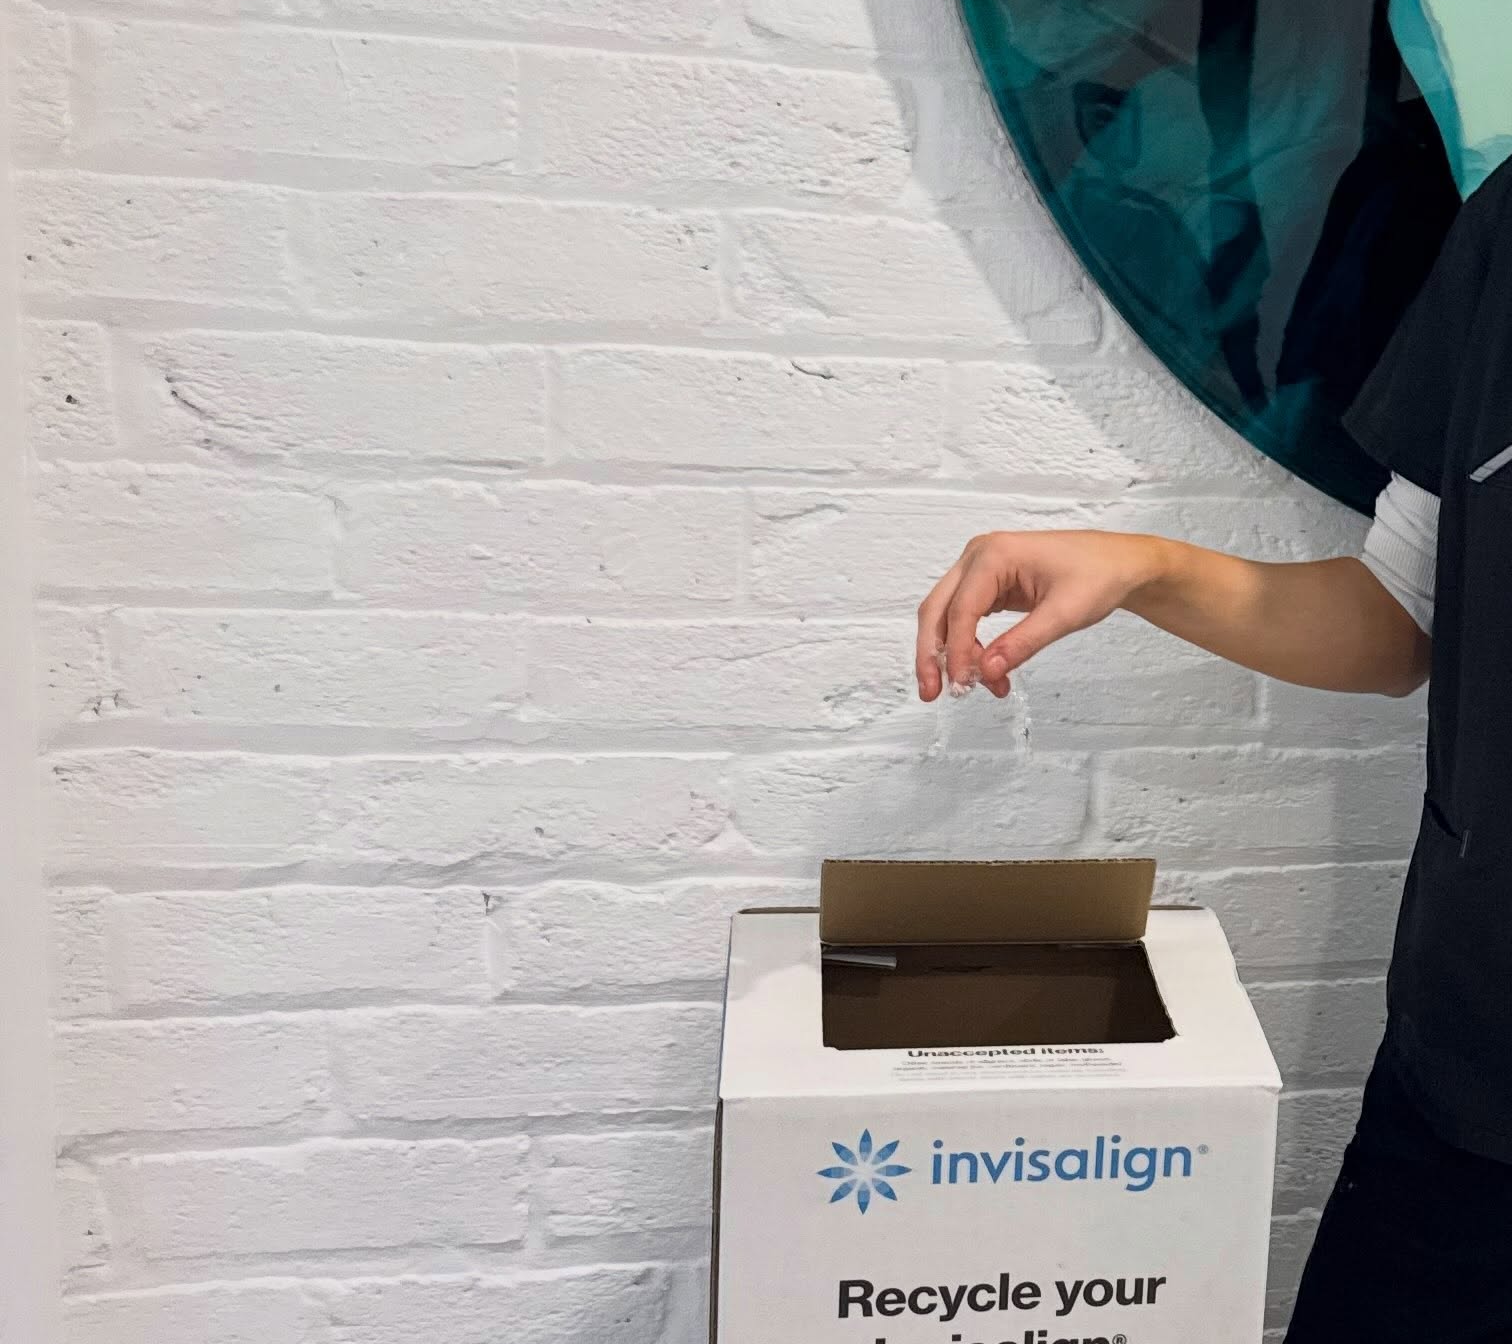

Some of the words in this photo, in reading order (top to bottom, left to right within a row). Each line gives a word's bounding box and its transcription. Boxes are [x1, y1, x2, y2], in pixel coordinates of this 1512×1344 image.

[906, 1046, 1036, 1059] Unaccepted
[838, 1272, 1042, 1322] Recycle
[1054, 1274, 1166, 1315] your
